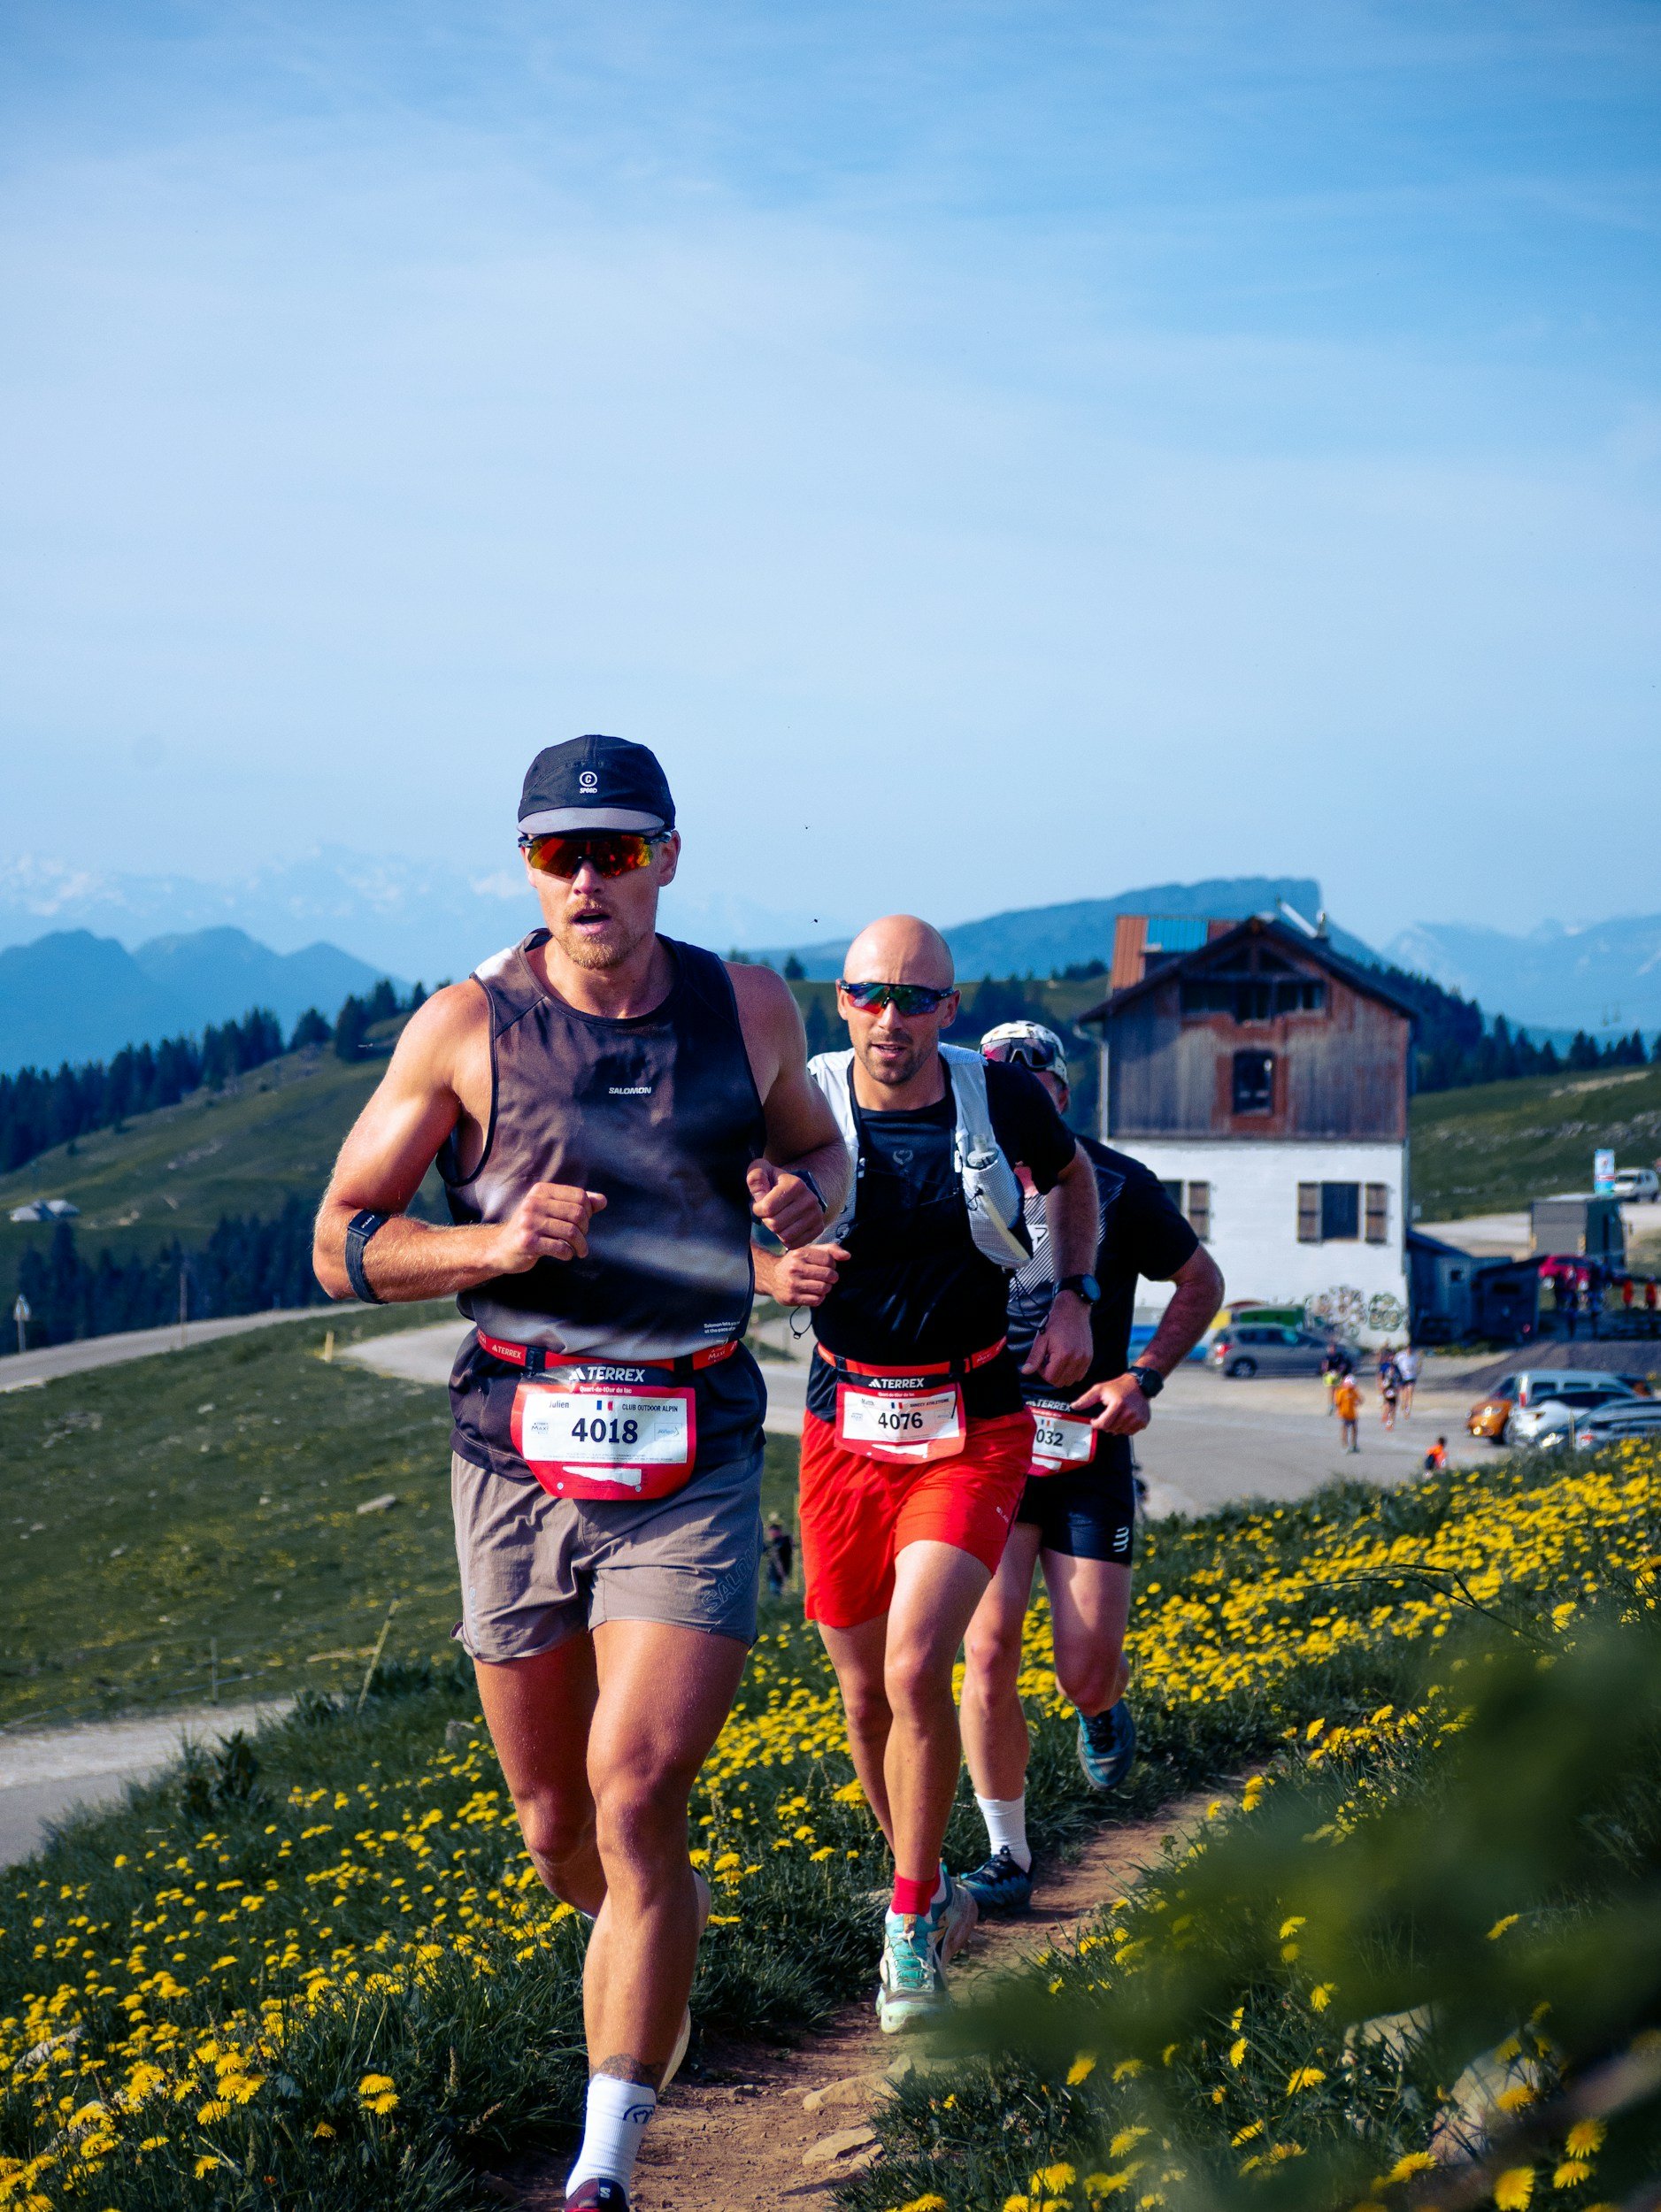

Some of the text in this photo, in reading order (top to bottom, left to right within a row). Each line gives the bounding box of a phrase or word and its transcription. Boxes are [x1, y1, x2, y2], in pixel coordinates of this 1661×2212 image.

[497, 1346, 521, 1359] TERREX
[587, 1366, 646, 1383] TERREX
[881, 1378, 925, 1389] TERREX
[1036, 1399, 1072, 1412] TERREX
[878, 1412, 923, 1430] 4076
[571, 1417, 638, 1444] 4018
[701, 1540, 757, 1614] SALO
